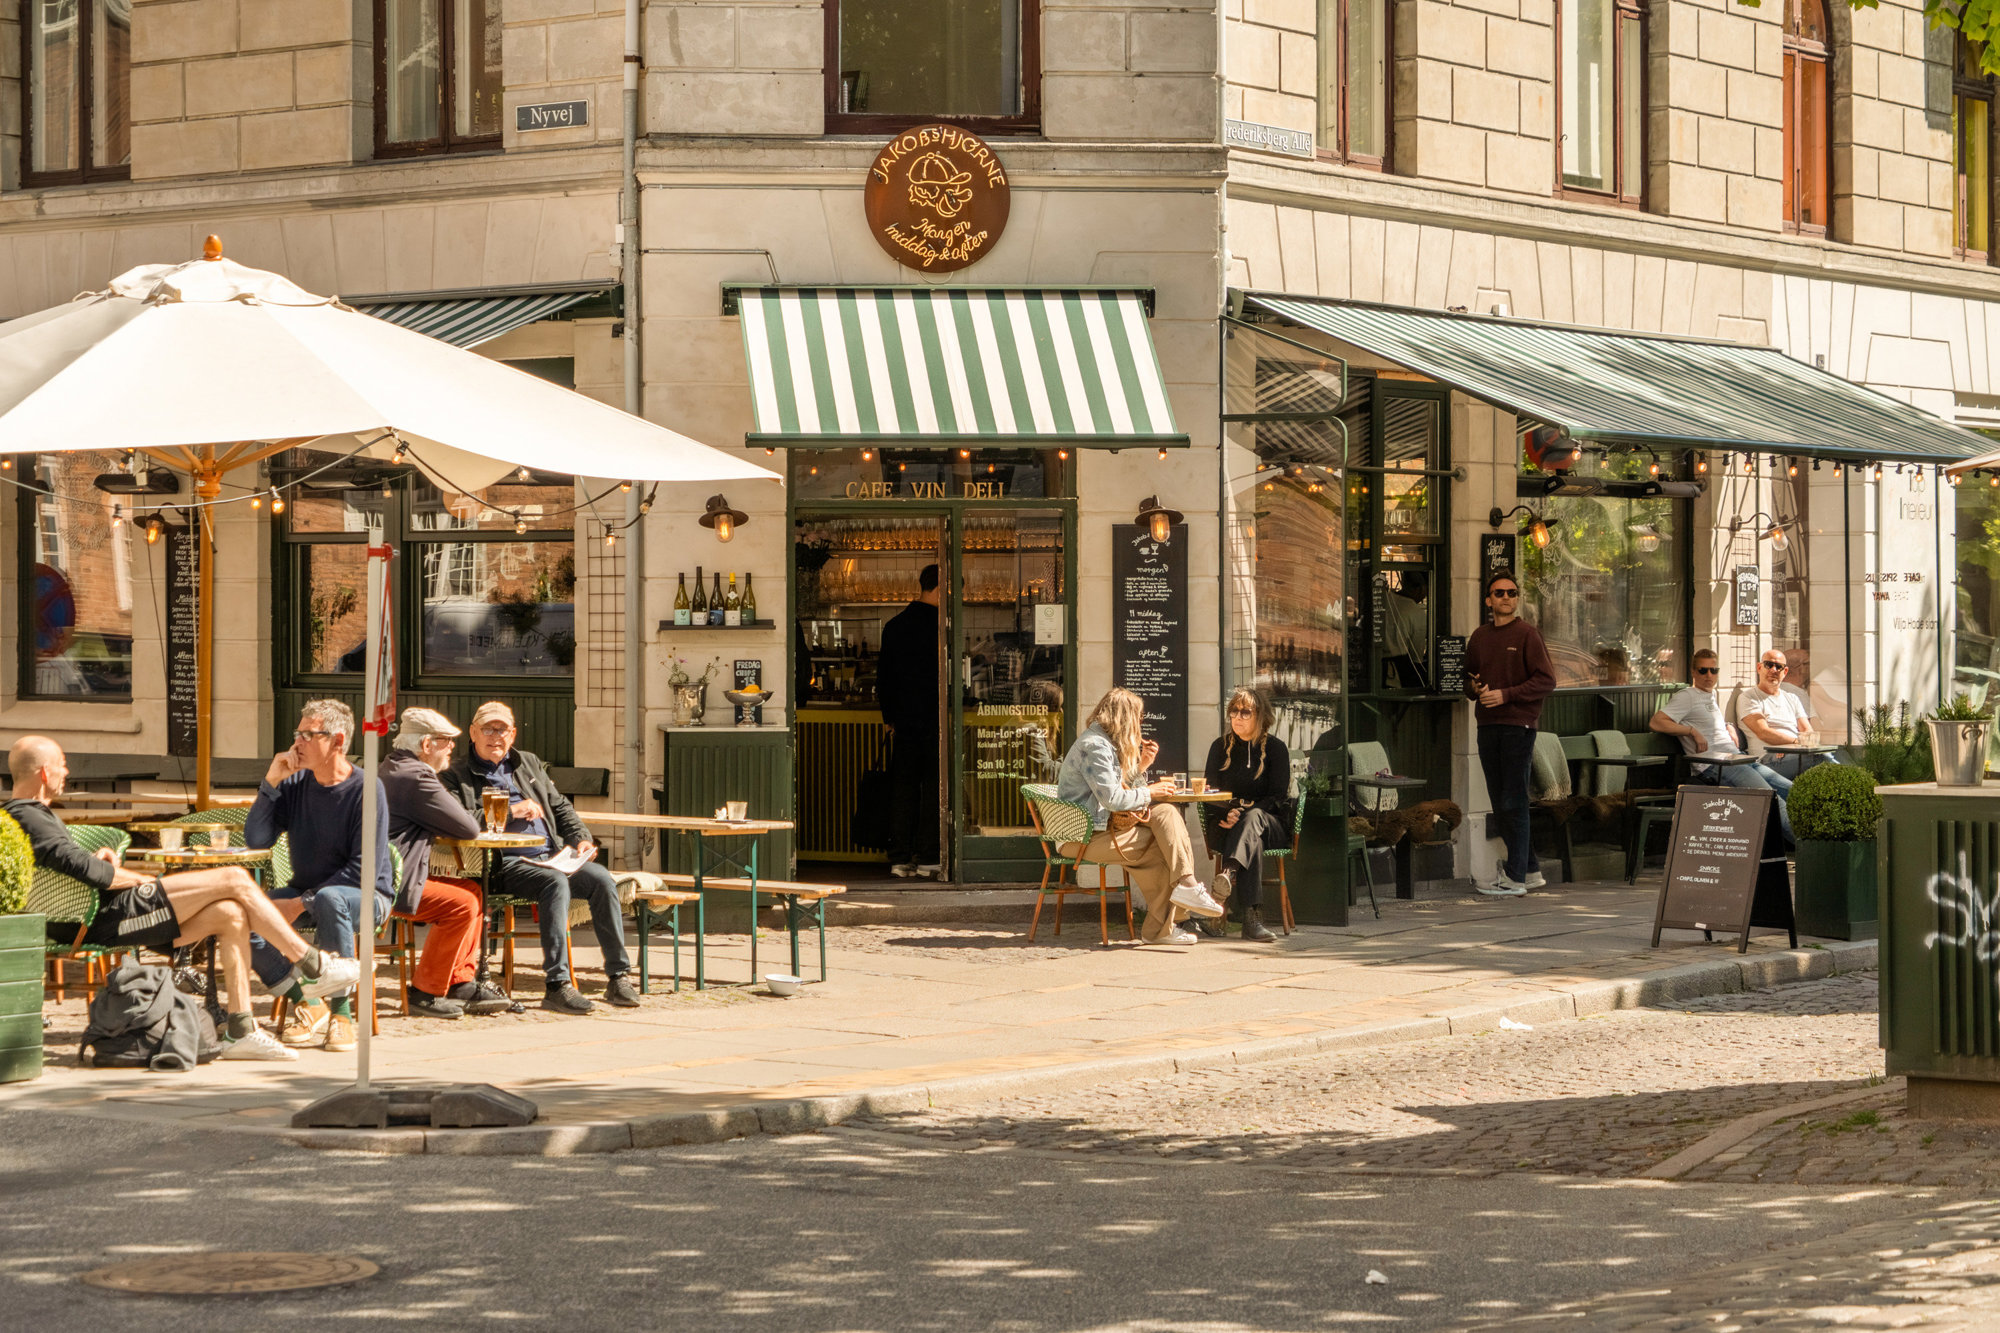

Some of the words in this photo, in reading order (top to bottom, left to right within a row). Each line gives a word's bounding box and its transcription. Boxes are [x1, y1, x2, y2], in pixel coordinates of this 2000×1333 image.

[530, 104, 573, 128] Nyvej
[1225, 121, 1289, 151] rederiksberg
[1291, 132, 1311, 151] Allé
[941, 128, 1006, 189] HJØRNE
[910, 218, 971, 248] Morgen
[884, 226, 939, 267] middag
[939, 247, 950, 260] &
[951, 230, 988, 261] aften
[845, 481, 893, 498] CAFE
[911, 481, 946, 498] VIN
[963, 481, 1005, 498] DELI
[1138, 648, 1160, 659] aften
[736, 661, 761, 670] FREDAG
[977, 701, 1049, 716] ÅBNINGSTIDER
[977, 728, 1014, 738] Man-Lør
[976, 759, 994, 769] Søn
[995, 759, 1005, 769] 10
[1012, 759, 1025, 769] 20
